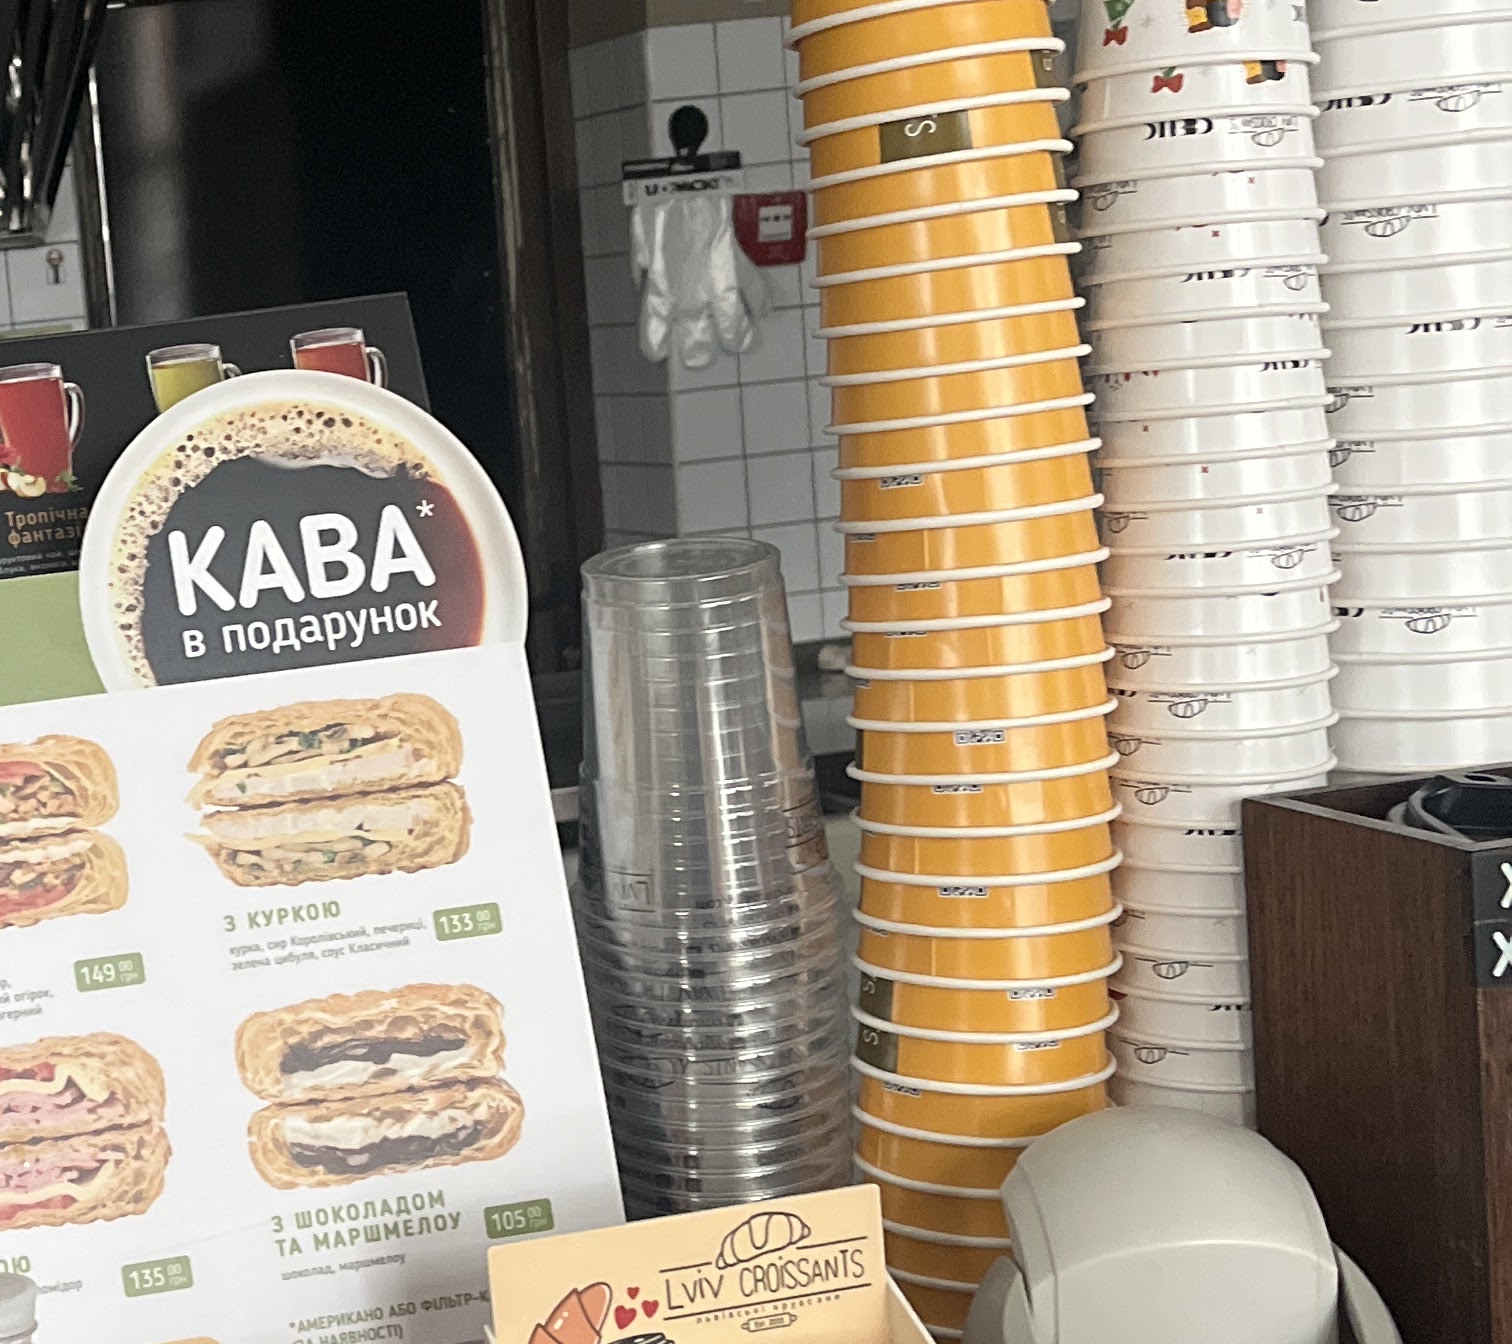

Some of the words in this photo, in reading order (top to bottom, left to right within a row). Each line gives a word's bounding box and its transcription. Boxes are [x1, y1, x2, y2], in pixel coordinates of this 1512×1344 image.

[3, 506, 89, 532] Тропічна
[182, 627, 207, 659] в
[220, 599, 444, 655] подарунок
[223, 914, 237, 933] З
[246, 899, 342, 932] КУРКОЮ
[438, 911, 475, 936] 133
[79, 962, 116, 986] 149
[270, 1211, 286, 1235] З
[292, 1188, 448, 1231] ШОКОЛАДОМ
[274, 1235, 305, 1259] ТА
[312, 1208, 465, 1254] МАРШМЕЛОУ
[489, 1206, 528, 1233] 105
[128, 1265, 166, 1291] 135
[388, 1301, 418, 1319] АБО
[419, 1290, 491, 1316] ФІЛЬТР-К
